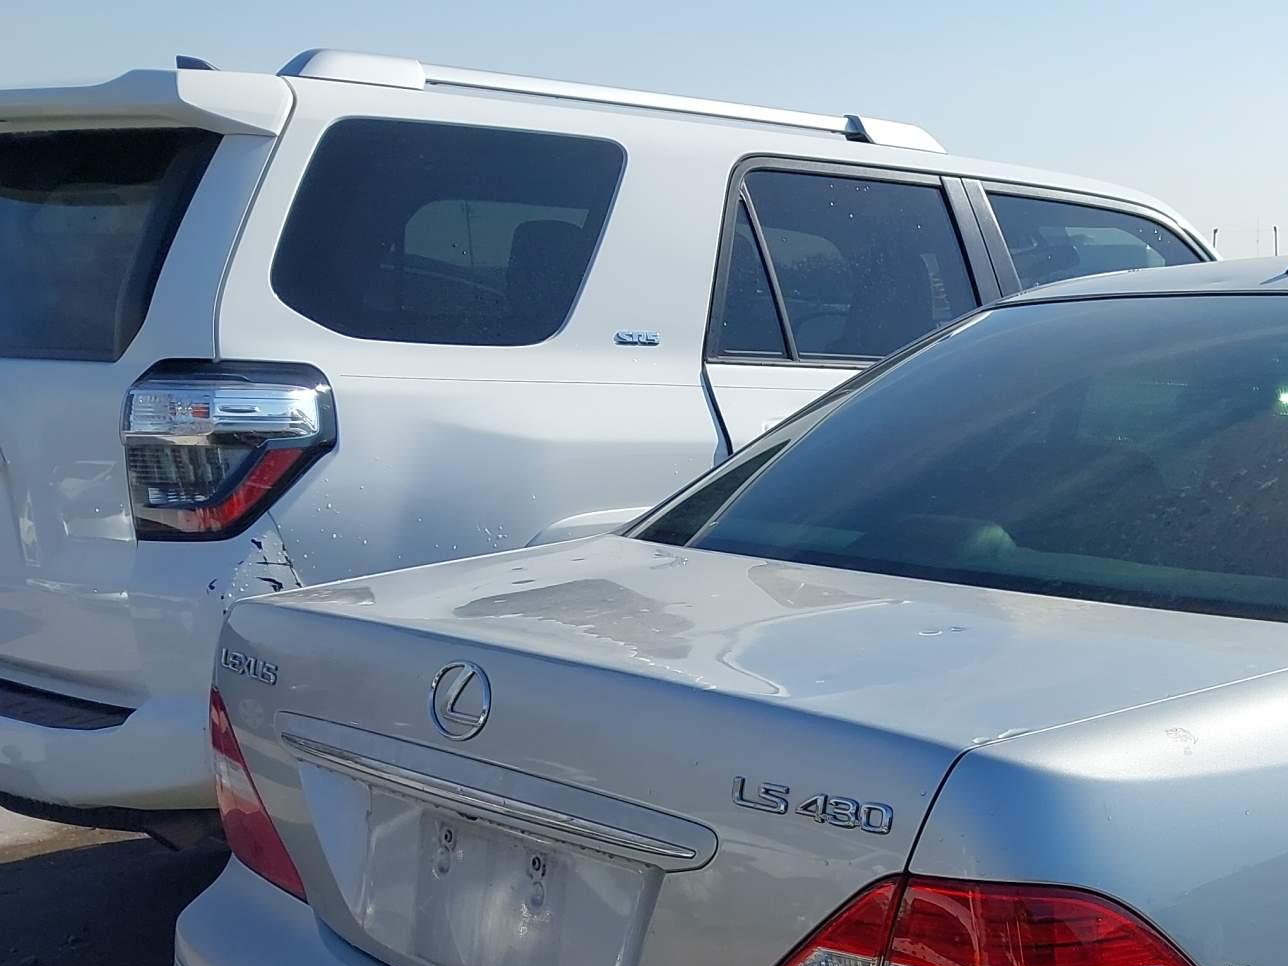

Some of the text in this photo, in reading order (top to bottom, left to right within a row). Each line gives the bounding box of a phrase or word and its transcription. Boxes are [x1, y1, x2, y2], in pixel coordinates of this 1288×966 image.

[613, 330, 660, 346] SR5
[221, 648, 278, 685] LEXUS
[732, 775, 894, 835] LS 430
